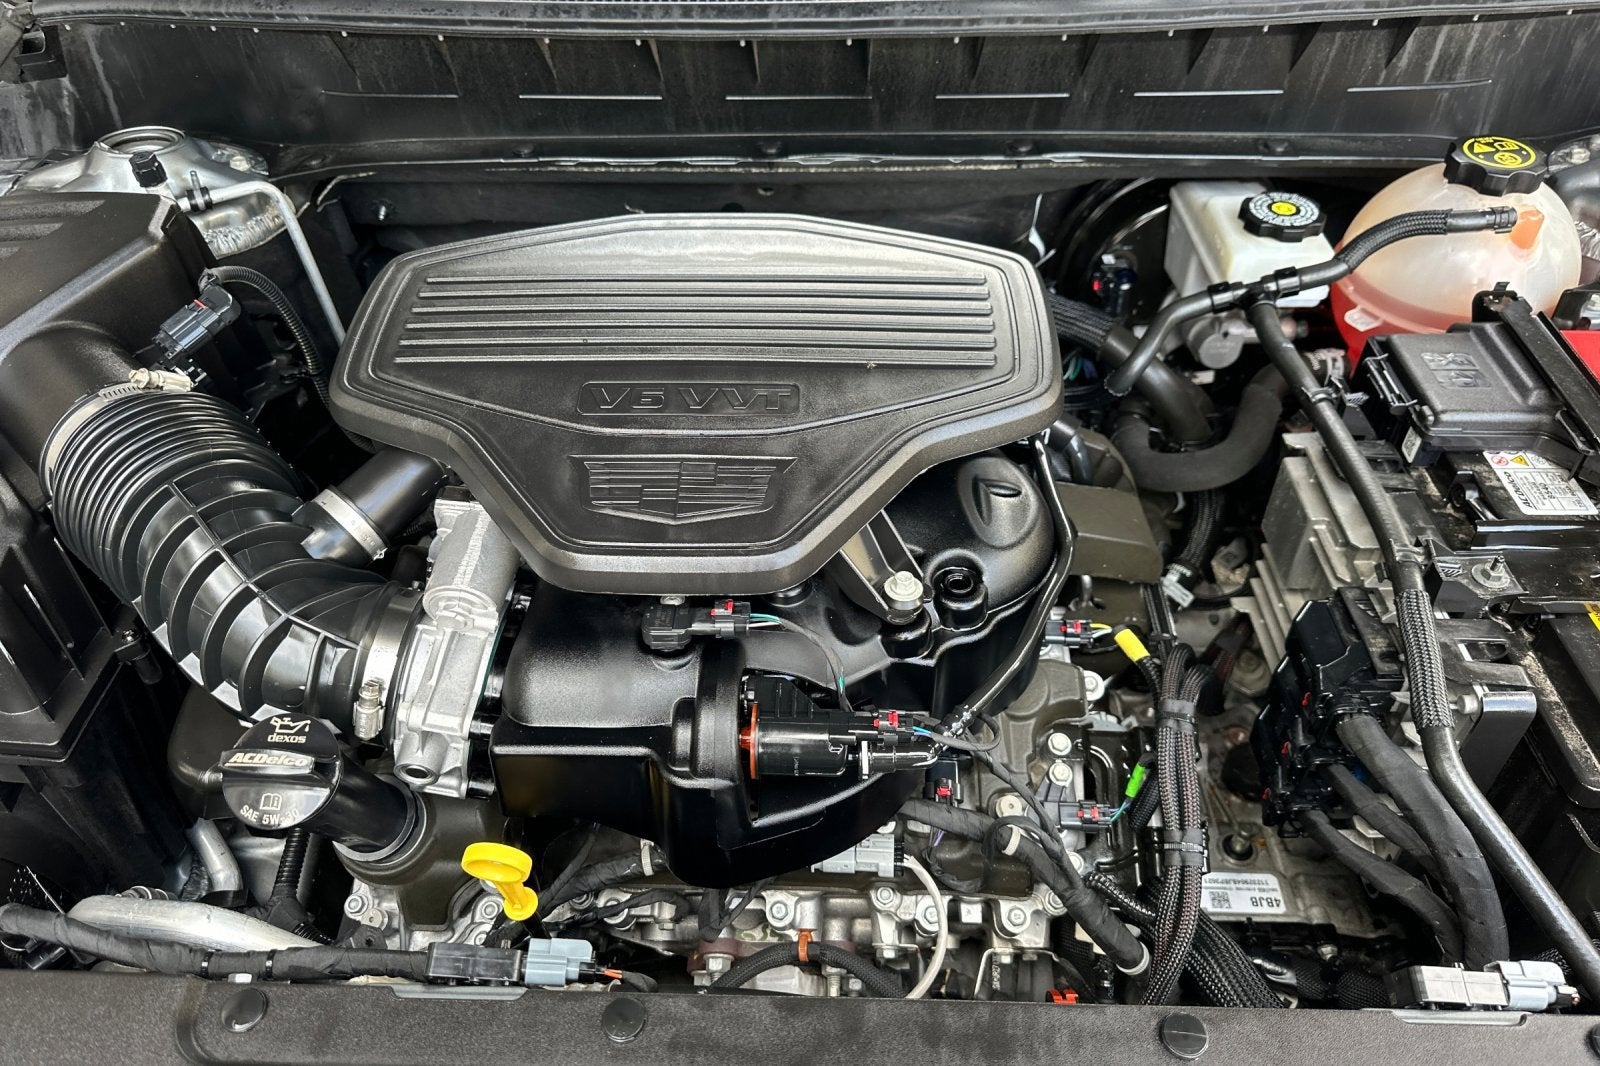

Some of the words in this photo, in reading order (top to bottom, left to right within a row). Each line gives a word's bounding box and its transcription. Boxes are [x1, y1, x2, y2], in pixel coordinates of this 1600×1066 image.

[590, 387, 665, 409] V6
[678, 387, 791, 410] VVT
[1503, 471, 1534, 509] ACDelco
[267, 733, 307, 744] dexos
[227, 752, 309, 767] ACDelco
[240, 804, 260, 823] SAE
[1249, 896, 1282, 908] 4BJB
